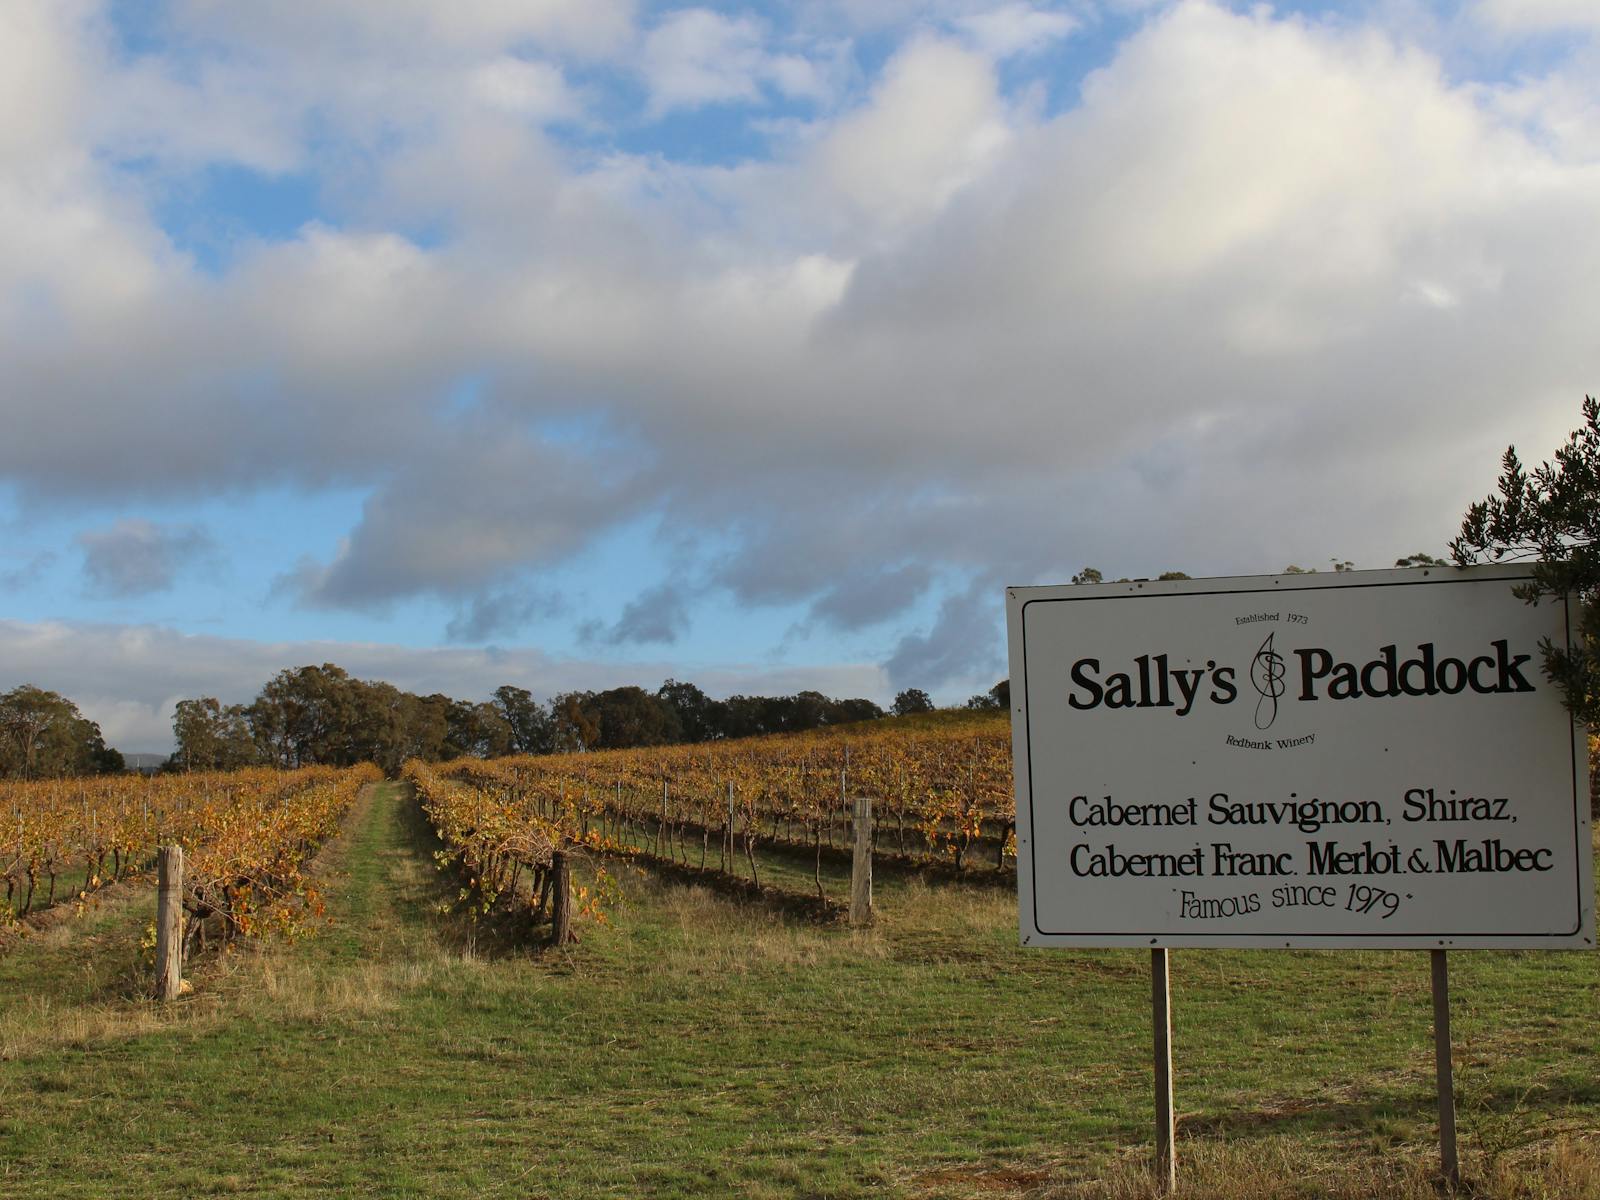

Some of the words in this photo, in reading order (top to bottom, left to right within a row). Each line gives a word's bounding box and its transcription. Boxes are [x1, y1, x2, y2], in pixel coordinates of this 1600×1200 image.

[1235, 612, 1280, 626] Established
[1287, 612, 1309, 625] 1973
[1068, 653, 1237, 716] Sally's
[1293, 639, 1536, 701] Paddock
[1225, 734, 1272, 750] Redbank
[1277, 733, 1316, 749] Winery
[1069, 796, 1198, 826] Cabernet
[1207, 793, 1391, 833] Sauvignon,
[1402, 788, 1517, 823] Shiraz,
[1070, 844, 1205, 877] Cabernet
[1433, 839, 1554, 873] Malbec
[1271, 883, 1336, 908] since
